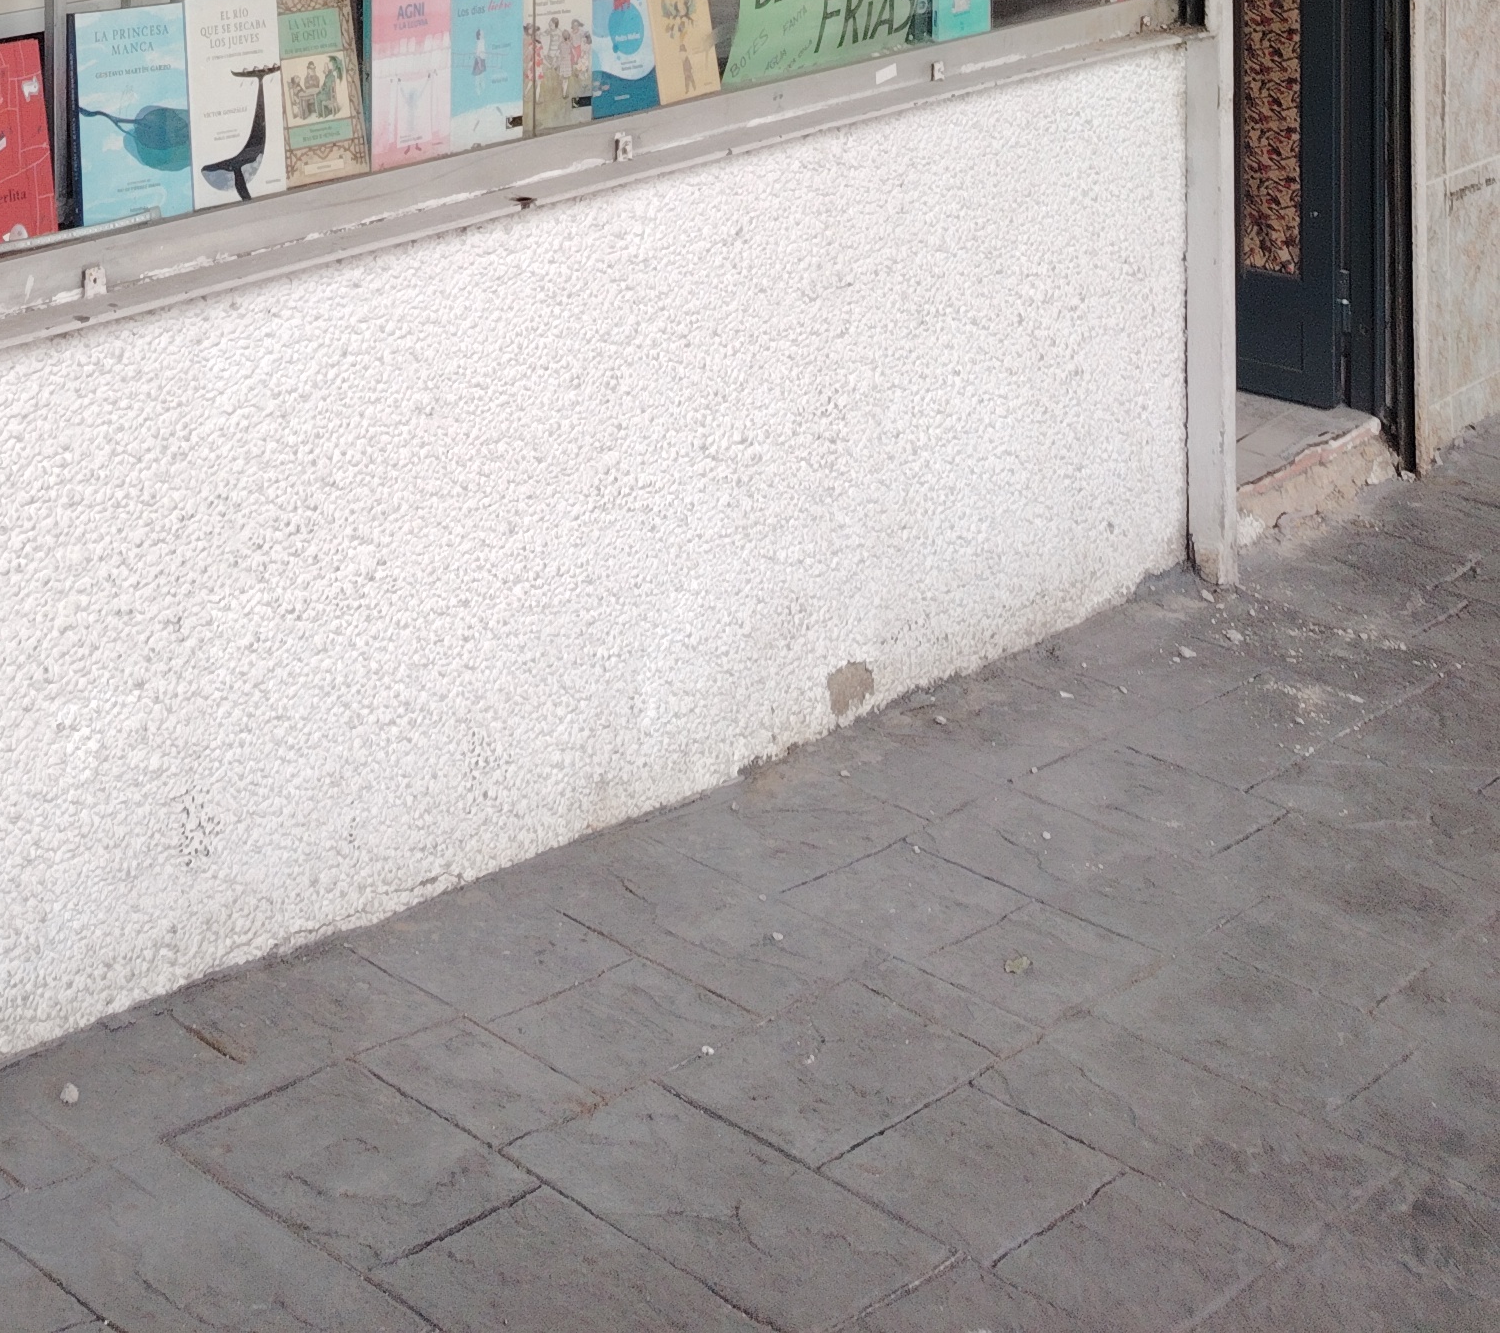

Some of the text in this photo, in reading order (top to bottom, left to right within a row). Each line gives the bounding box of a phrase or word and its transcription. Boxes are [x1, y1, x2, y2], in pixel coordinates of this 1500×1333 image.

[220, 7, 249, 21] EL RÍO
[397, 1, 425, 21] AGNI
[457, 8, 470, 18] Los
[471, 4, 486, 16] días
[95, 24, 169, 43] LA PRINCESA
[200, 19, 267, 39] QUE SE SECABA
[111, 41, 154, 56] MANCA
[210, 33, 260, 49] LOS JUEVES
[729, 27, 770, 78] BOTES
[95, 69, 124, 80] GUSTAVO
